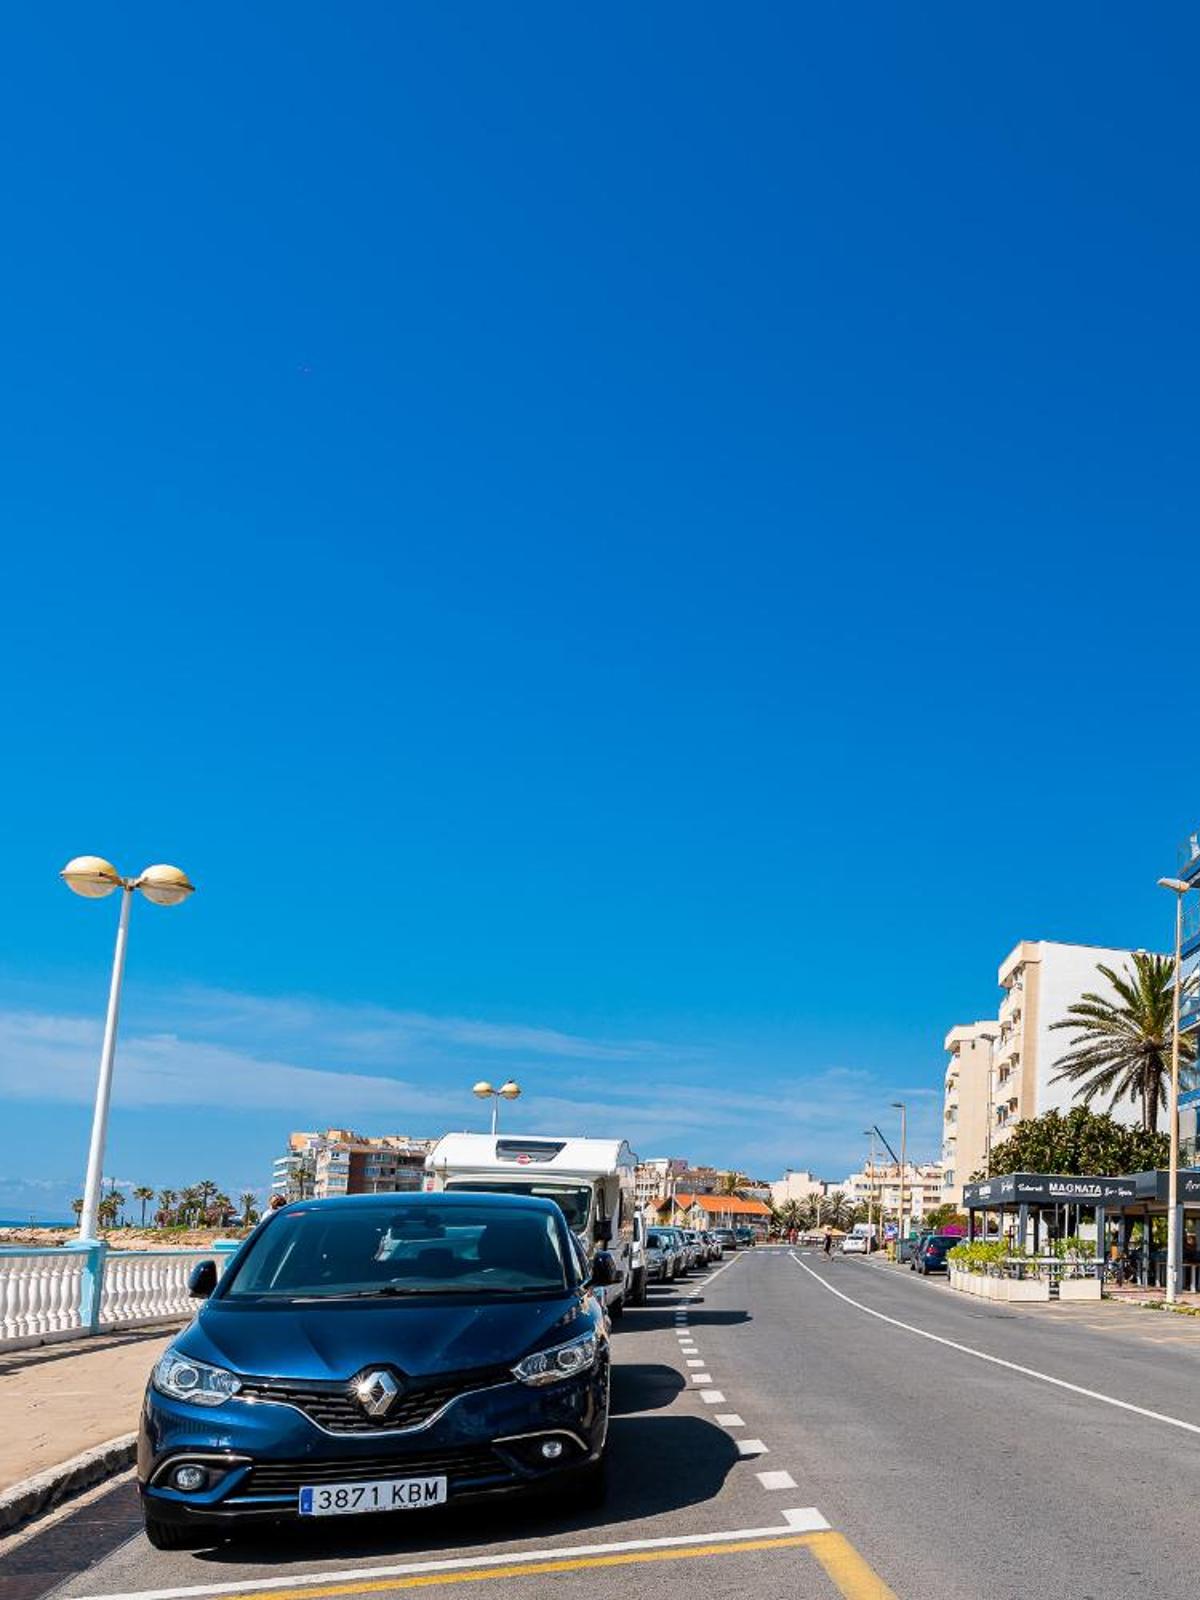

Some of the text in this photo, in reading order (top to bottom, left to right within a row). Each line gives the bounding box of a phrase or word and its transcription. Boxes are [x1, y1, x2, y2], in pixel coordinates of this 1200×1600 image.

[1049, 1183, 1102, 1194] MAGNATA
[319, 1482, 439, 1510] 3871 KBM
